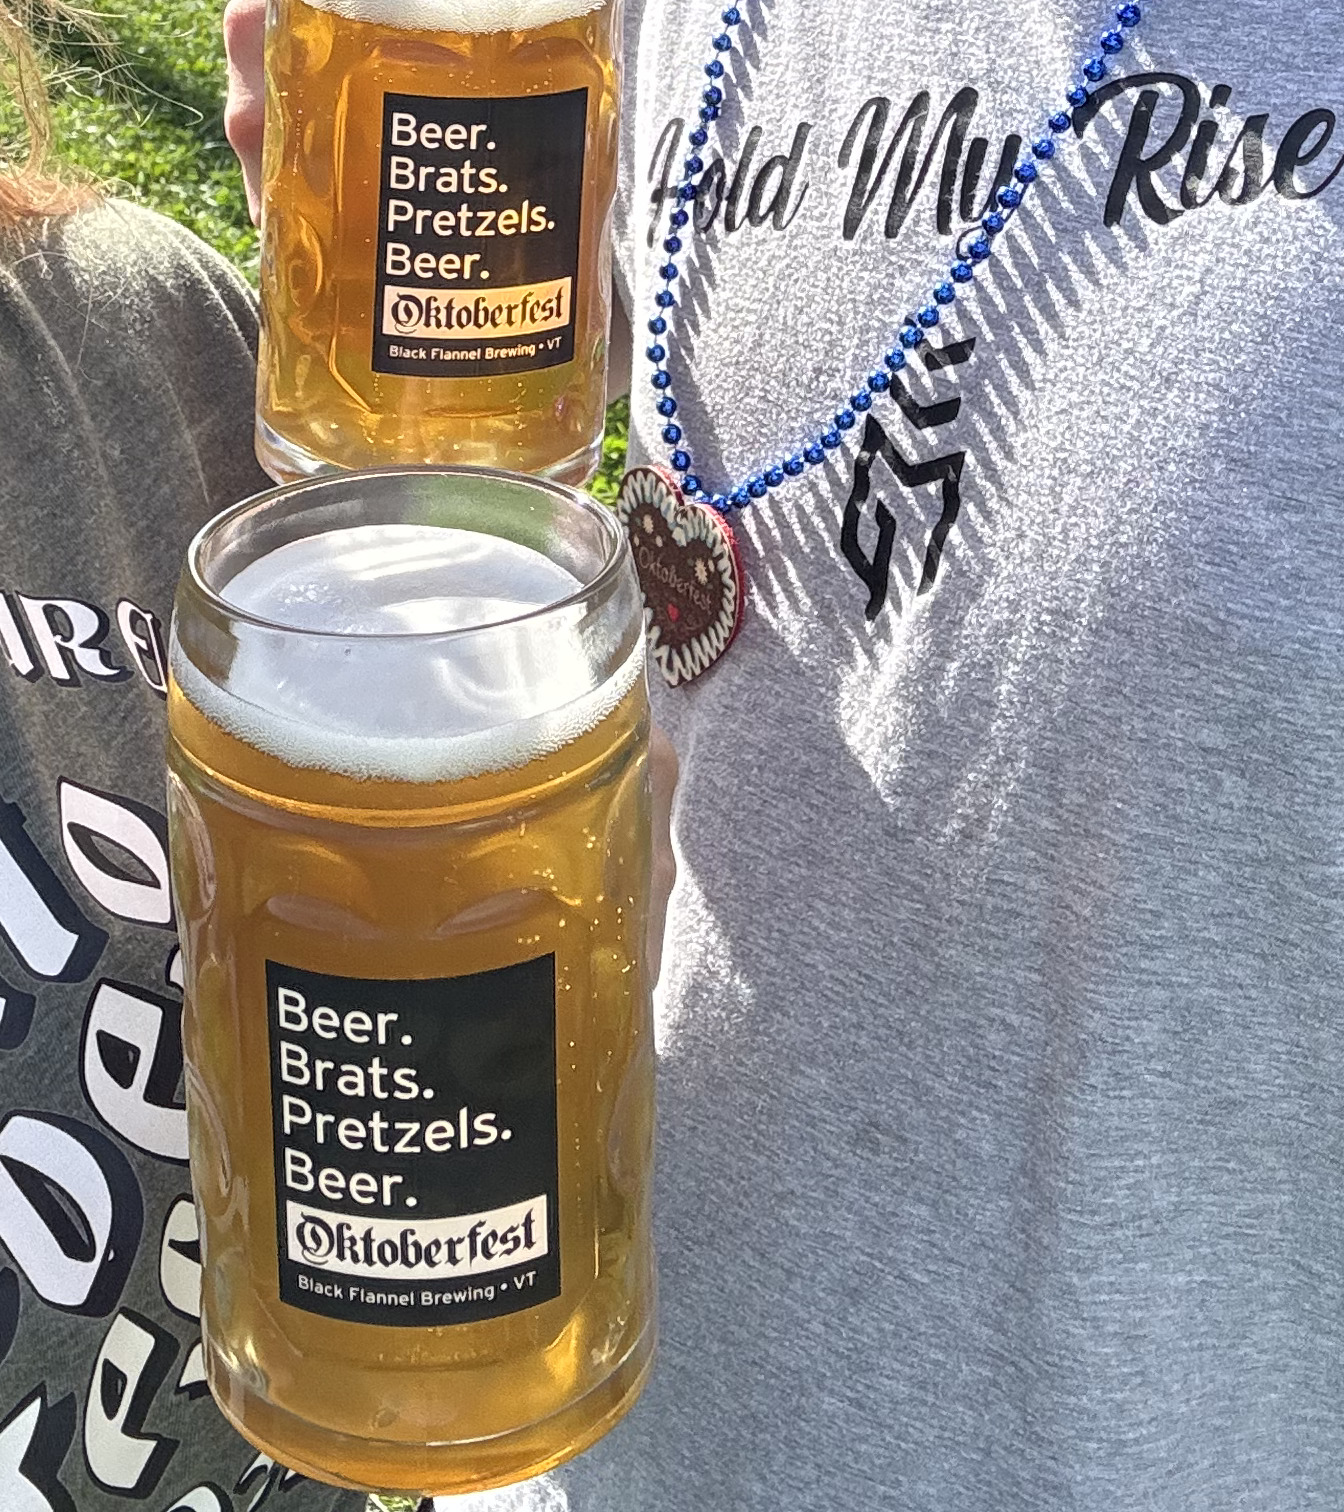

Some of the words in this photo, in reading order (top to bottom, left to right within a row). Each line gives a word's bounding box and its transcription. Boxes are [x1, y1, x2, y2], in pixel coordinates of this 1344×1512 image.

[390, 111, 496, 150] Beer.
[389, 155, 508, 194] Brats.
[838, 86, 1033, 263] My
[387, 198, 555, 238] Pretzels.
[385, 241, 490, 280] Beer.
[390, 285, 565, 335] Oktoberfest
[389, 344, 427, 361] Black
[431, 347, 481, 361] Flannel
[485, 343, 536, 360] Brewing
[546, 336, 562, 351] VT
[638, 545, 714, 616] Oktoberfest
[277, 986, 414, 1046] Beer.
[280, 1039, 435, 1101] Brats.
[282, 1093, 513, 1154] Pretzels.
[284, 1146, 418, 1209] Beer.
[295, 1207, 537, 1269] Oktoberfest
[297, 1273, 343, 1301] Black
[349, 1287, 415, 1307] Flannel
[420, 1284, 496, 1307] Brewing
[513, 1270, 537, 1291] VT
